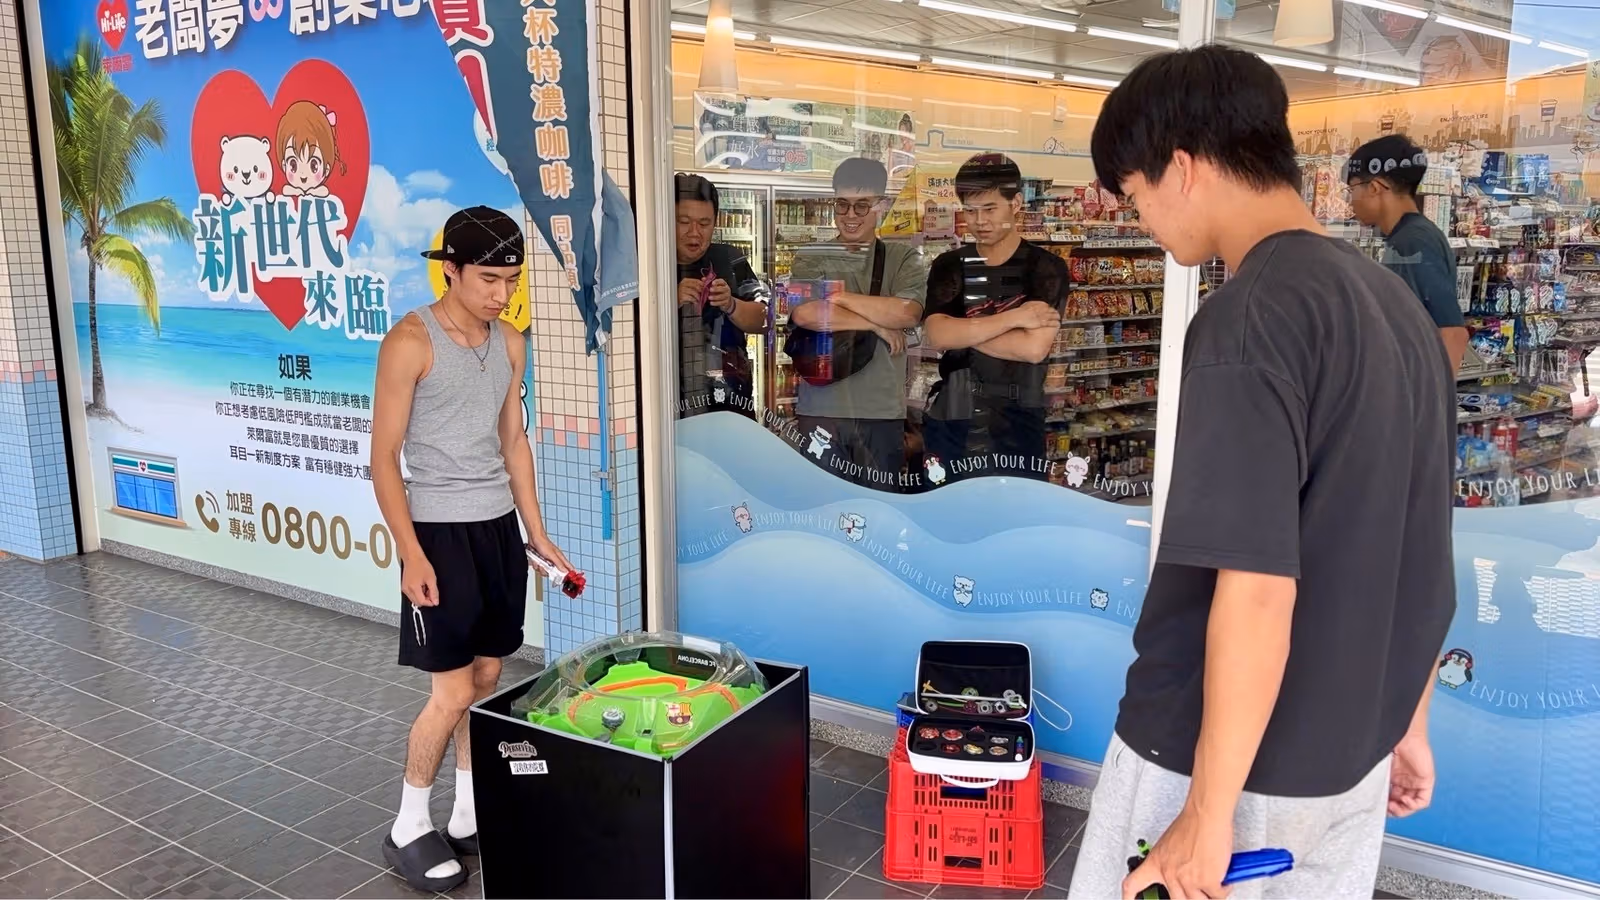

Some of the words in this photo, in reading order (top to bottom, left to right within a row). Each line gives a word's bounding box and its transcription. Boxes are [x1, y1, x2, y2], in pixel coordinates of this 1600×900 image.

[520, 0, 574, 199] 杯特濃咖啡
[194, 197, 345, 296] 新世代
[304, 269, 388, 335] 來臨
[278, 353, 312, 381] 如果
[229, 381, 371, 410] 你正在尋找一個有潛力的創業機會
[692, 394, 712, 408] LIFE
[247, 426, 360, 456] 萊爾富就是您最優質的選擇
[762, 406, 784, 432] YOUR
[786, 425, 807, 448] LIFE
[229, 445, 301, 470] 耳目一新制度方案
[830, 453, 864, 478] ENJOY
[866, 466, 894, 486] YOUR
[898, 471, 923, 487] LIFE
[950, 455, 988, 475] ENJOY
[992, 453, 1026, 470] YOUR
[1031, 455, 1058, 476] LIFE
[1093, 473, 1138, 497] ENJOY
[1458, 478, 1519, 500] ENJOY
[1524, 471, 1577, 493] YOUR
[226, 489, 255, 516] 加盟
[228, 517, 257, 543] 專線
[262, 502, 402, 569] 0800-0
[755, 511, 786, 528] ENJOY
[788, 510, 815, 526] YOUR
[817, 515, 839, 533] LIFE
[687, 542, 710, 557] YOUR
[710, 529, 729, 549] LIFE
[861, 535, 896, 564] ENJOY
[896, 556, 924, 585] YOUR
[925, 576, 949, 600] LIFE
[977, 591, 1014, 608] ENJOY
[1015, 587, 1051, 605] YOUR
[1055, 587, 1082, 606] LIFE
[1116, 600, 1137, 620] EN
[1469, 679, 1529, 709] ENJOY
[1536, 688, 1590, 709] YOUR
